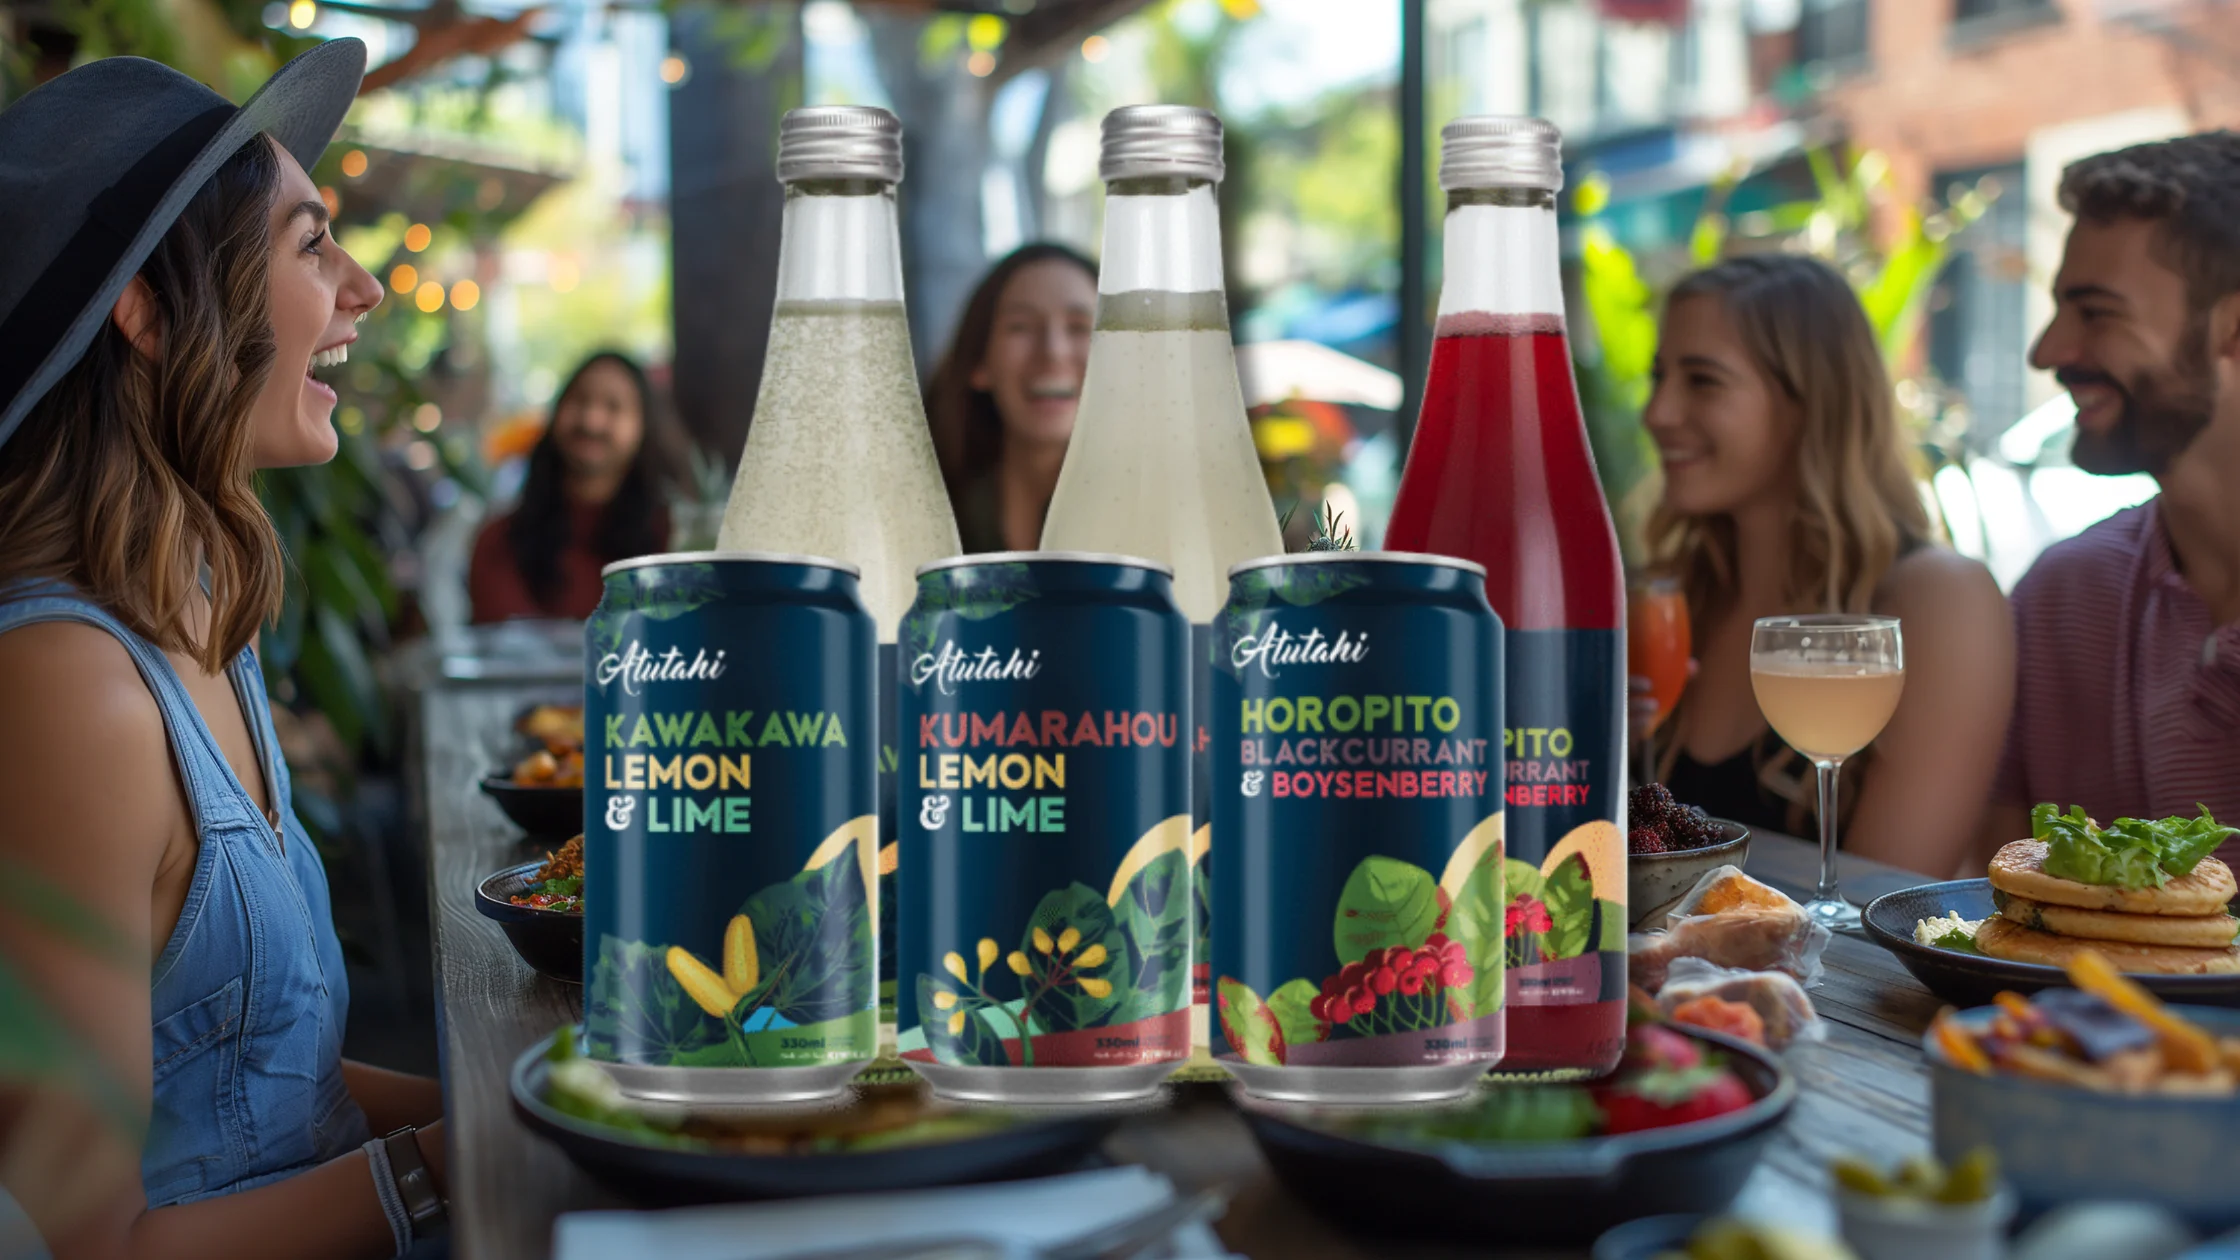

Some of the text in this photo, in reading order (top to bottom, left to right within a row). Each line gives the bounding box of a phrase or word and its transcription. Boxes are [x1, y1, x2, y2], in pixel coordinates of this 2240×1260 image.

[596, 639, 726, 697] Atutahi
[911, 639, 1041, 695] Atutahi
[1231, 621, 1369, 679] Atutahi
[605, 710, 848, 749] KAWAKAWA
[919, 710, 1178, 748] KUMARAHOU
[1241, 695, 1460, 734] HOROPITO
[1241, 738, 1488, 766] BLACKCURRANT
[1503, 760, 1590, 781] RRANT
[605, 754, 751, 790] LEMON
[919, 753, 1066, 790] LEMON
[1240, 770, 1489, 798] & BOYSENBERRY
[605, 794, 751, 834] & LIME
[919, 794, 1066, 833] & LIME
[780, 1036, 826, 1050] 330ml
[1095, 1036, 1139, 1050] 330ml
[1423, 1036, 1468, 1051] 330ml
